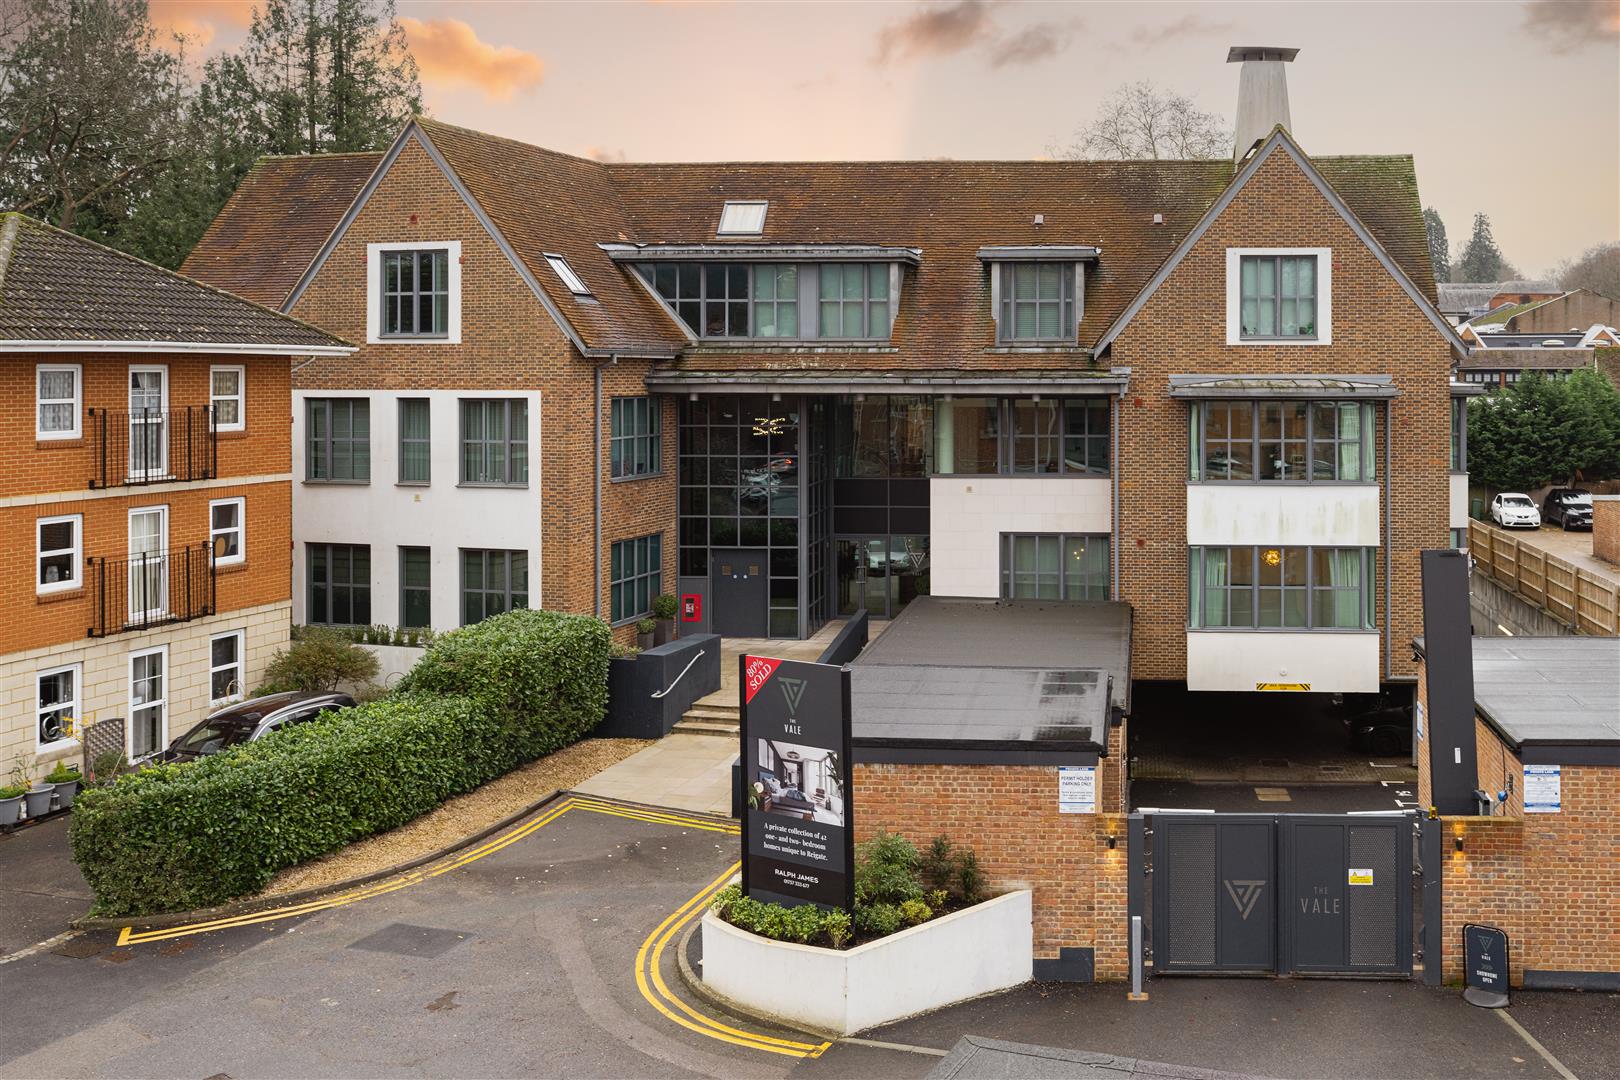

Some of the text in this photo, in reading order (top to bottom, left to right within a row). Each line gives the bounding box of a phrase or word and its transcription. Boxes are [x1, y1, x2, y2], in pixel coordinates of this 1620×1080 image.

[747, 659, 763, 678] 80%
[750, 663, 772, 690] SOLD
[784, 724, 802, 735] VALE
[769, 824, 787, 833] private
[788, 827, 813, 838] collection
[764, 841, 780, 851] homes
[782, 846, 799, 855] unique
[807, 852, 828, 861] Reigate.
[789, 837, 801, 845] two-
[802, 840, 826, 850] bedroom
[774, 869, 819, 884] RALPH JAMES
[1314, 886, 1328, 894] THE
[1300, 898, 1340, 913] VALE
